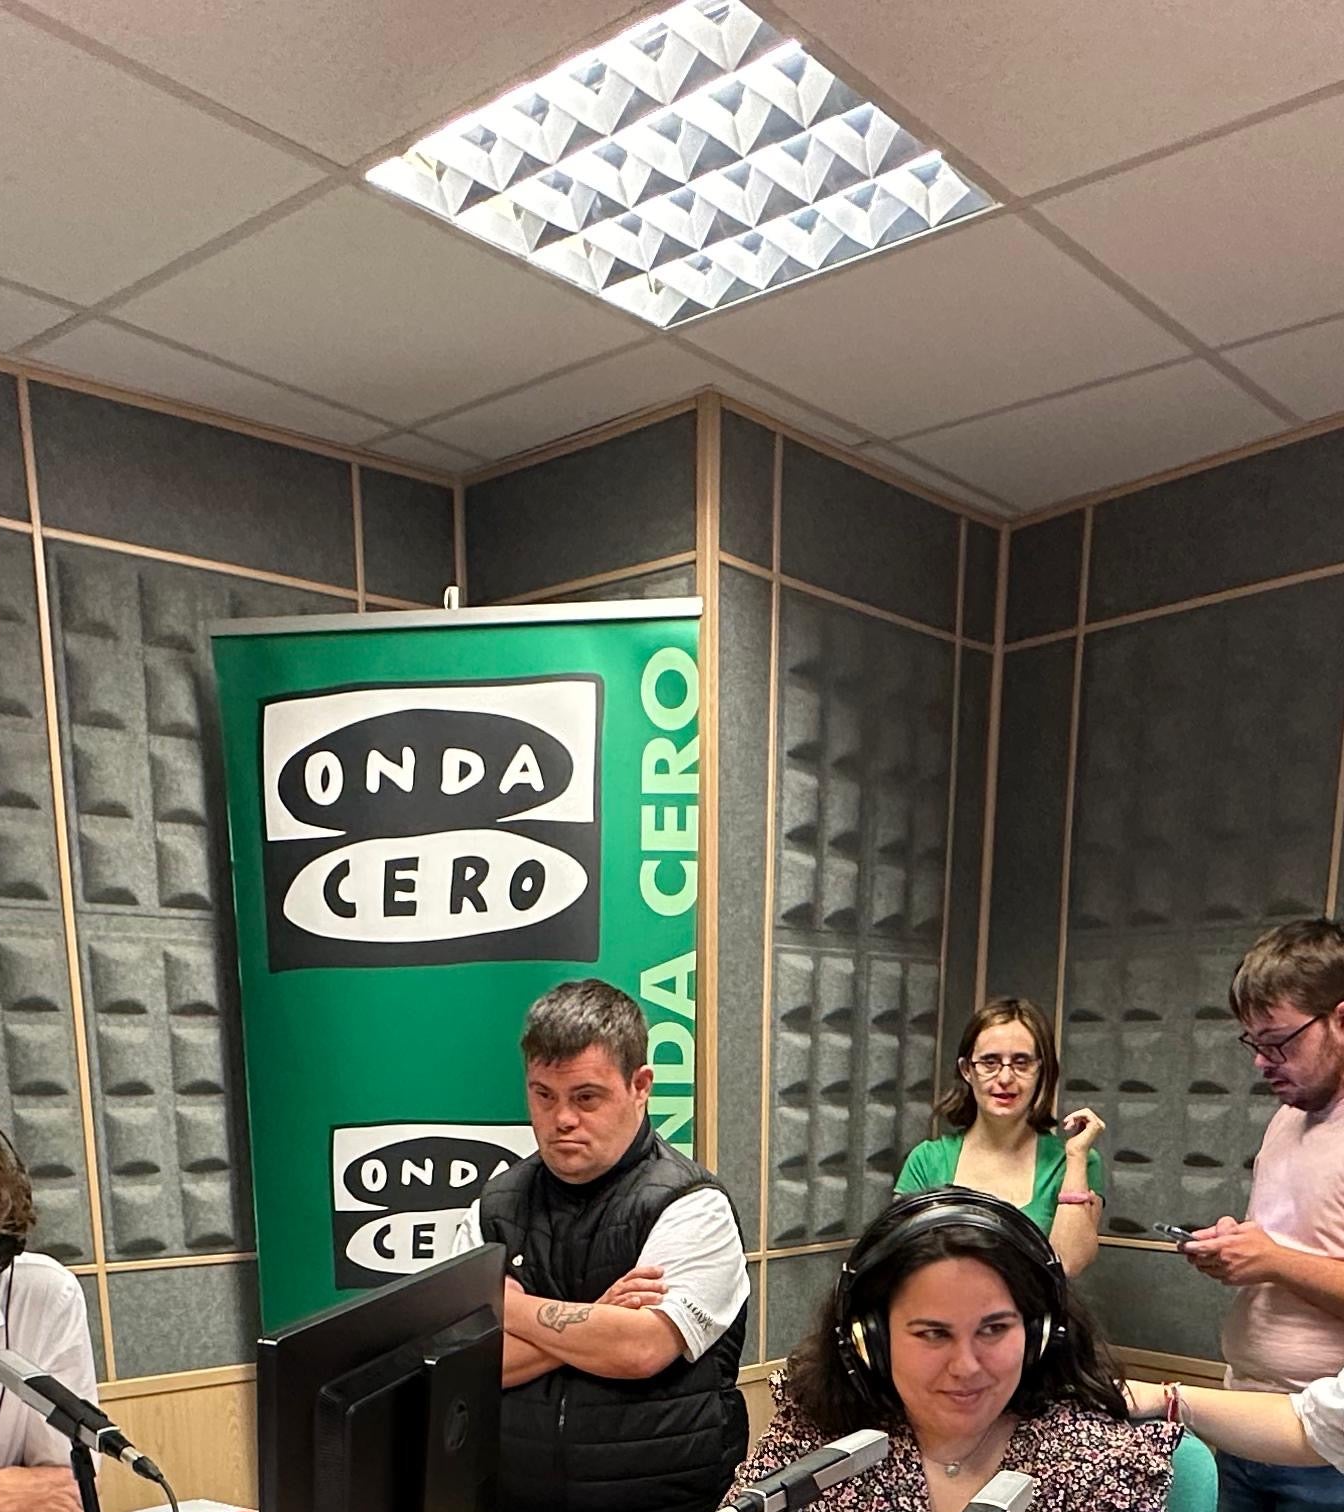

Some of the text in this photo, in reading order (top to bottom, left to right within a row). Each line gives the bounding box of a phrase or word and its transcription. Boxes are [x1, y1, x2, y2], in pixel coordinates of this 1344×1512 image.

[305, 744, 545, 806] ONDA
[323, 856, 545, 918] CERO
[640, 647, 699, 1161] NDA CERO
[361, 1158, 510, 1192] OND
[373, 1223, 462, 1260] CE
